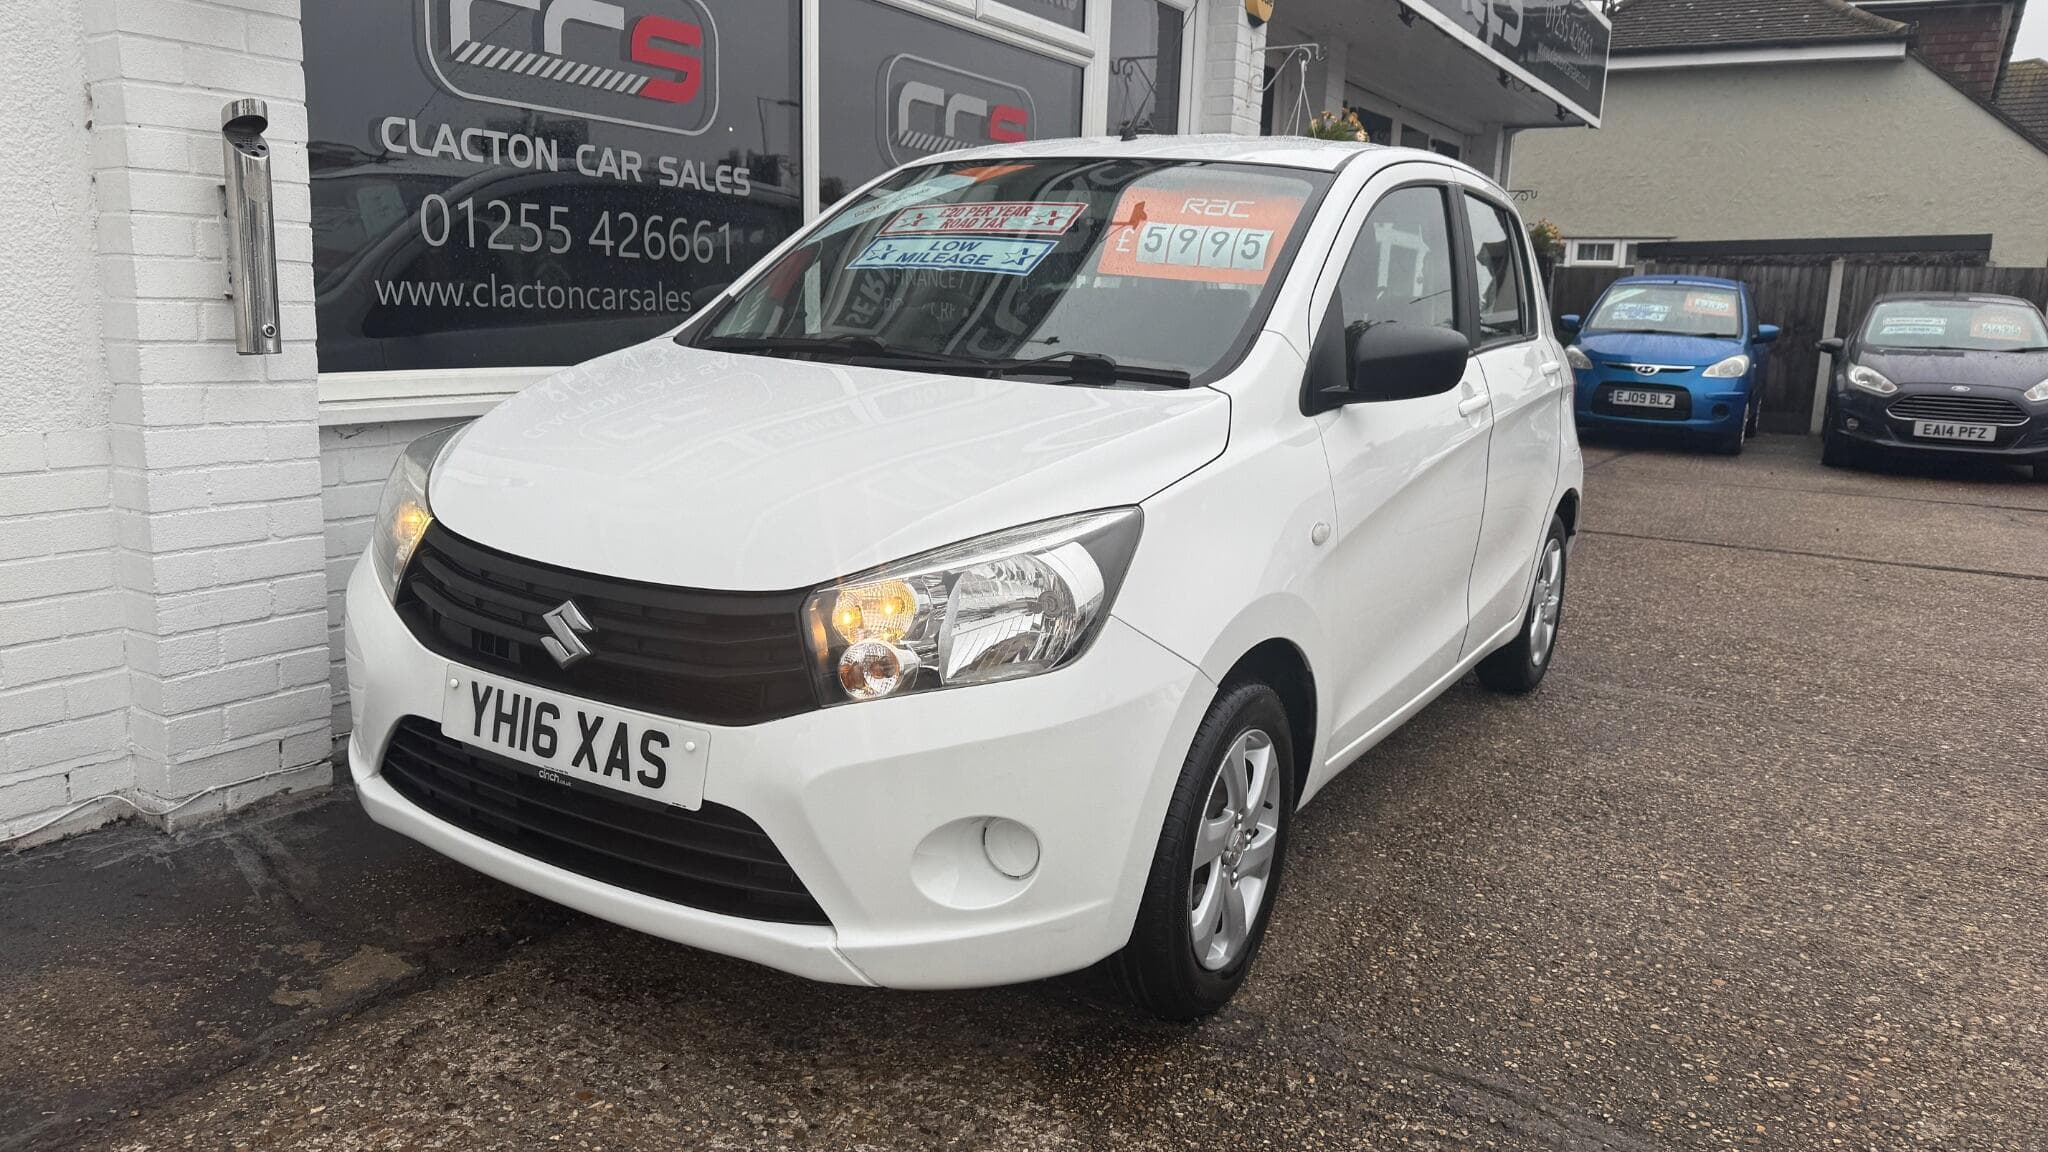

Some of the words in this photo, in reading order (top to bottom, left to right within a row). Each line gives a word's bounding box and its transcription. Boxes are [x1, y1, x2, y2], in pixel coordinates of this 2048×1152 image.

[381, 116, 559, 172] CLACTON
[576, 144, 643, 183] CAR
[658, 155, 752, 197] SALES
[938, 207, 961, 218] £20
[966, 206, 992, 217] PER
[998, 206, 1033, 217] YEAR
[420, 193, 572, 254] 01255
[588, 210, 732, 265] 426661
[941, 218, 974, 229] ROAD
[982, 218, 1009, 229] TAX
[928, 241, 982, 251] LOW
[896, 253, 993, 265] MILEAGE
[1616, 391, 1646, 403] EJ09
[1649, 393, 1672, 406] BLZ
[1922, 423, 1954, 436] EA14
[1959, 426, 1987, 439] PFZ
[471, 681, 561, 759] YH16
[571, 711, 670, 789] XAS
